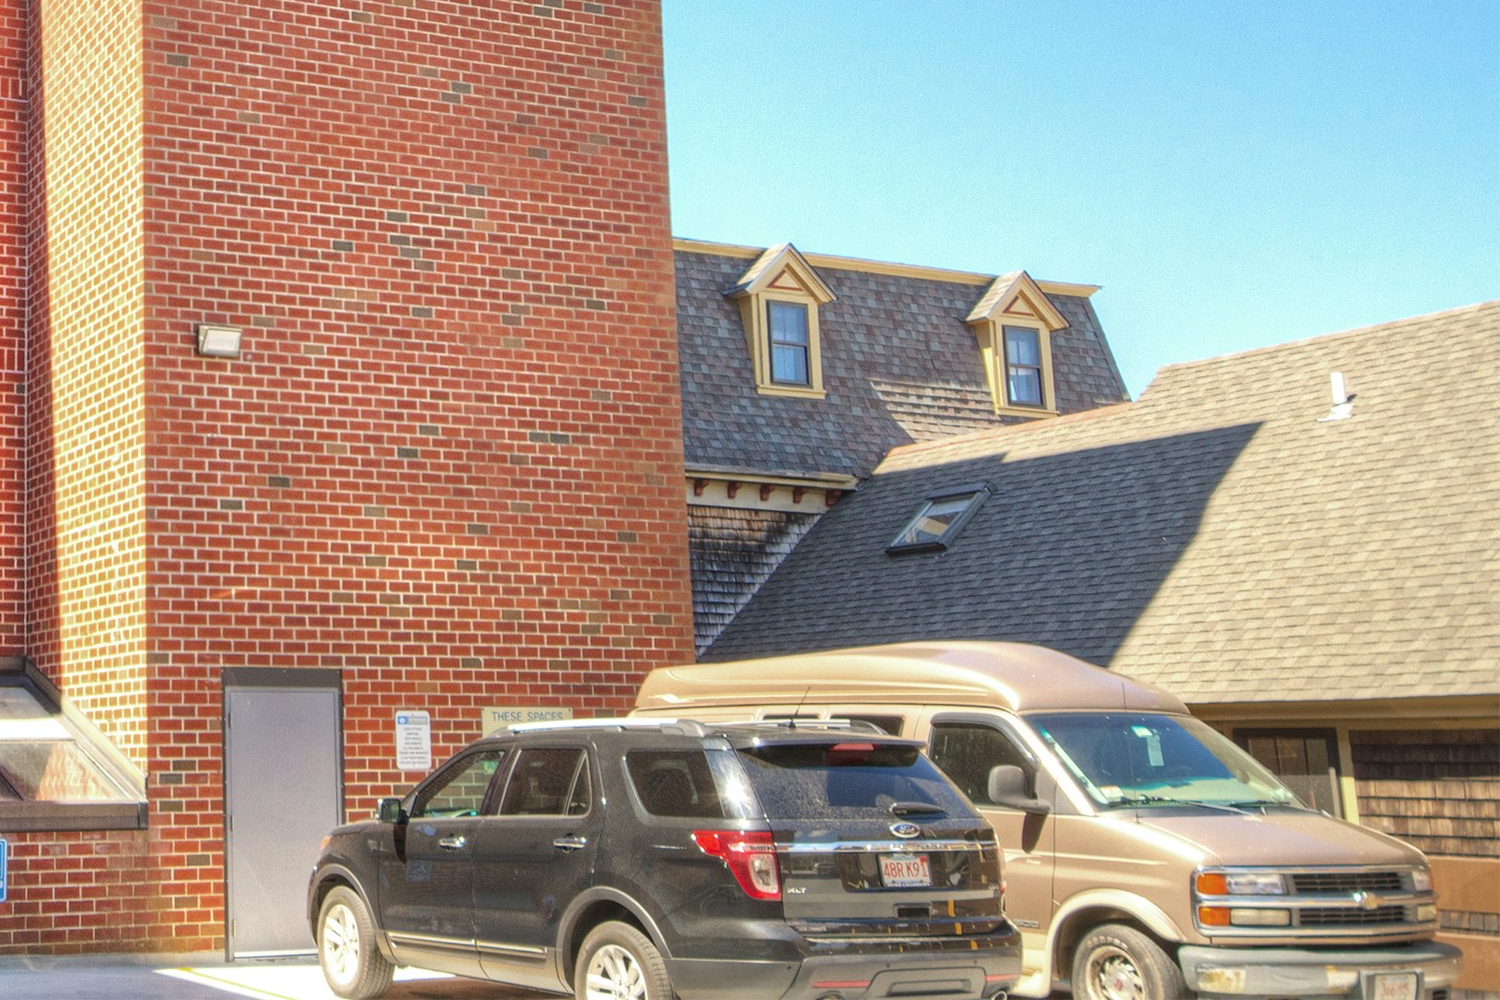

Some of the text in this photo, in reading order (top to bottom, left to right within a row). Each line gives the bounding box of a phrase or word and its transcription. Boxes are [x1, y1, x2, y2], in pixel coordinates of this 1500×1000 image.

[492, 711, 564, 721] THESE SPACES
[884, 862, 928, 878] 48R K91
